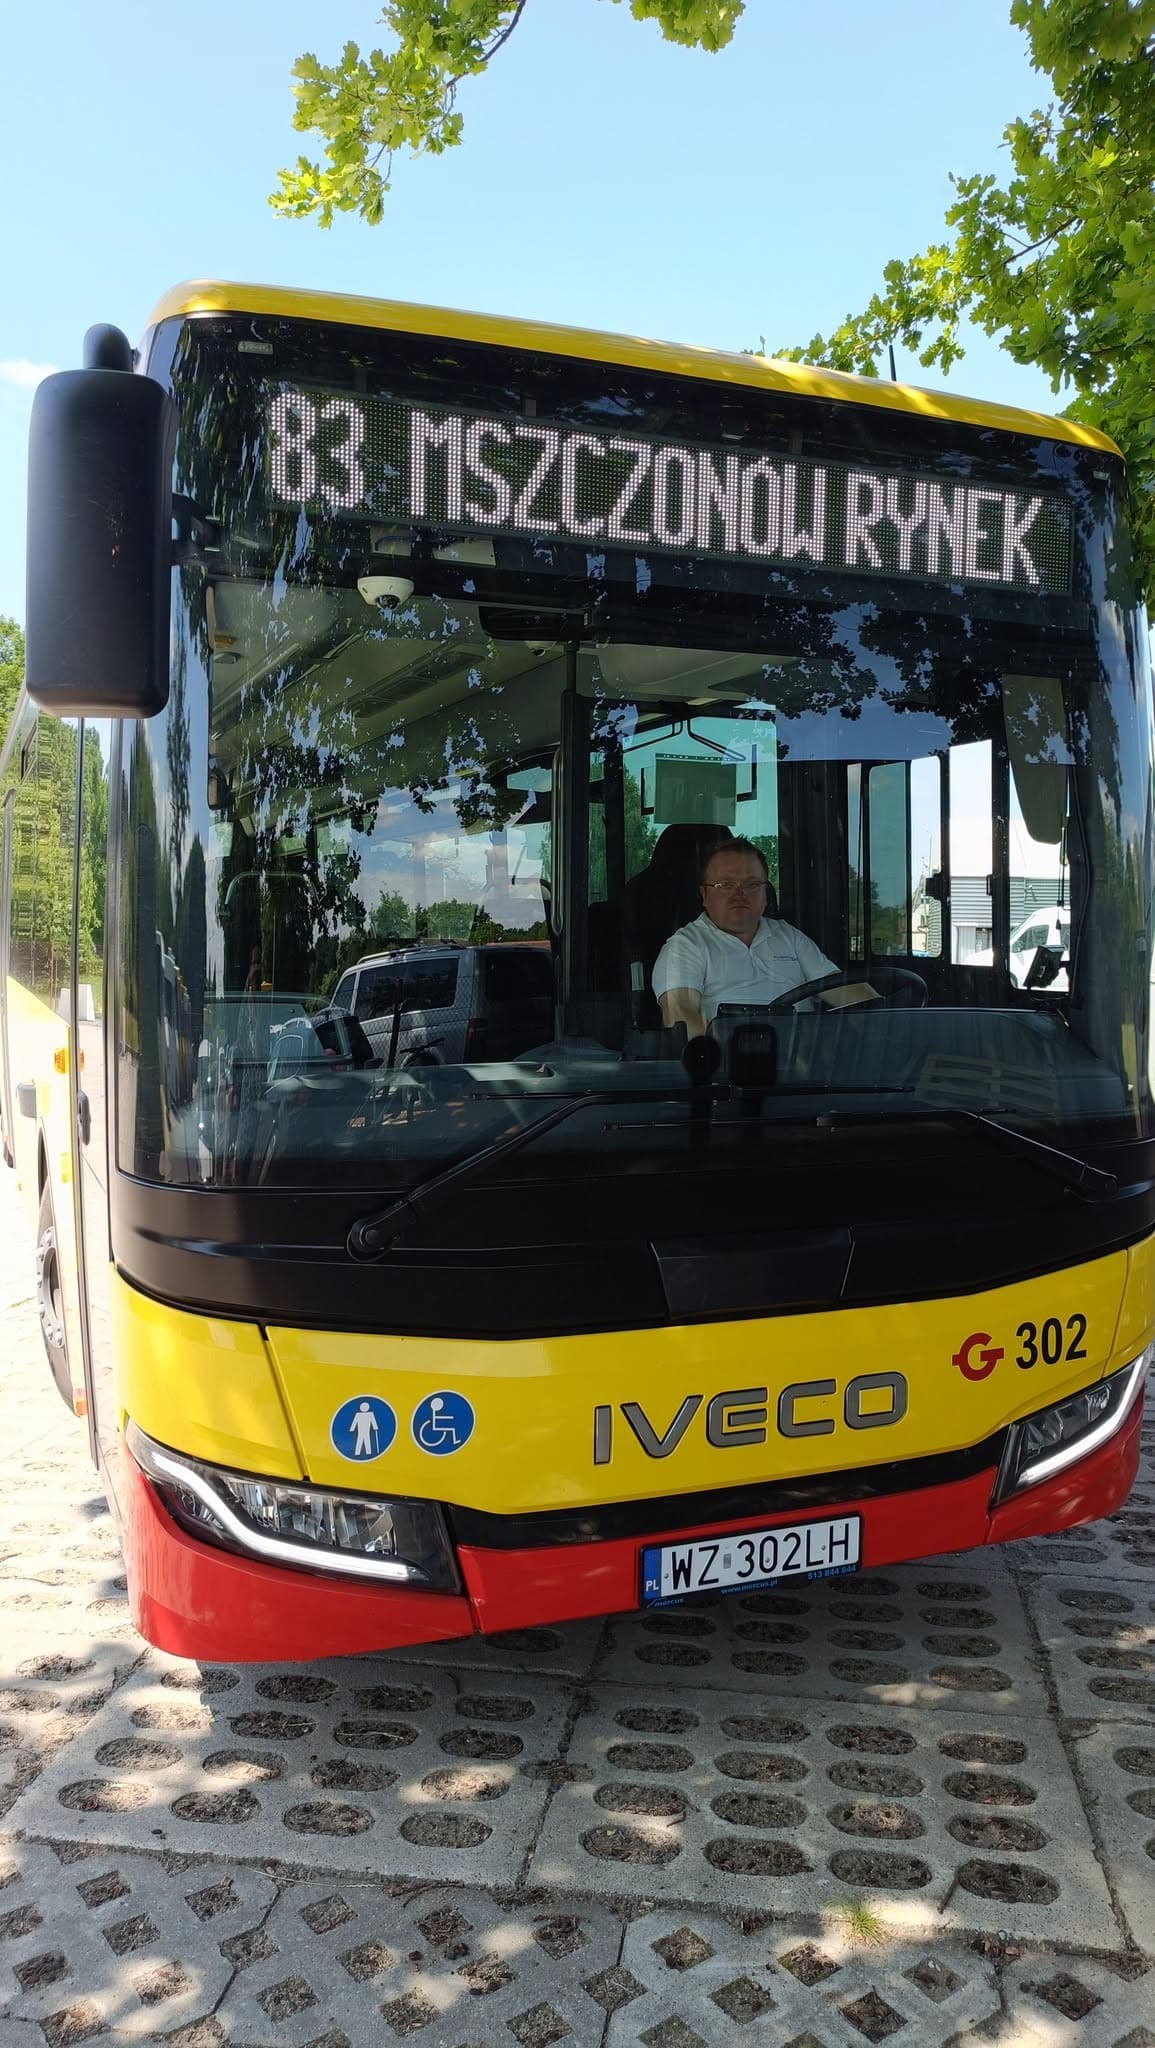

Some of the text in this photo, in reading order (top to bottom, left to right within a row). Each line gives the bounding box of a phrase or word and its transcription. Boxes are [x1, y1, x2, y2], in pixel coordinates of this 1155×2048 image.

[271, 391, 1043, 586] 83 MSZCZONÓW RYNEK
[1016, 1313, 1087, 1369] 302
[593, 1371, 908, 1465] IVECO
[645, 1580, 659, 1592] PL
[671, 1522, 850, 1590] WZ 302LH
